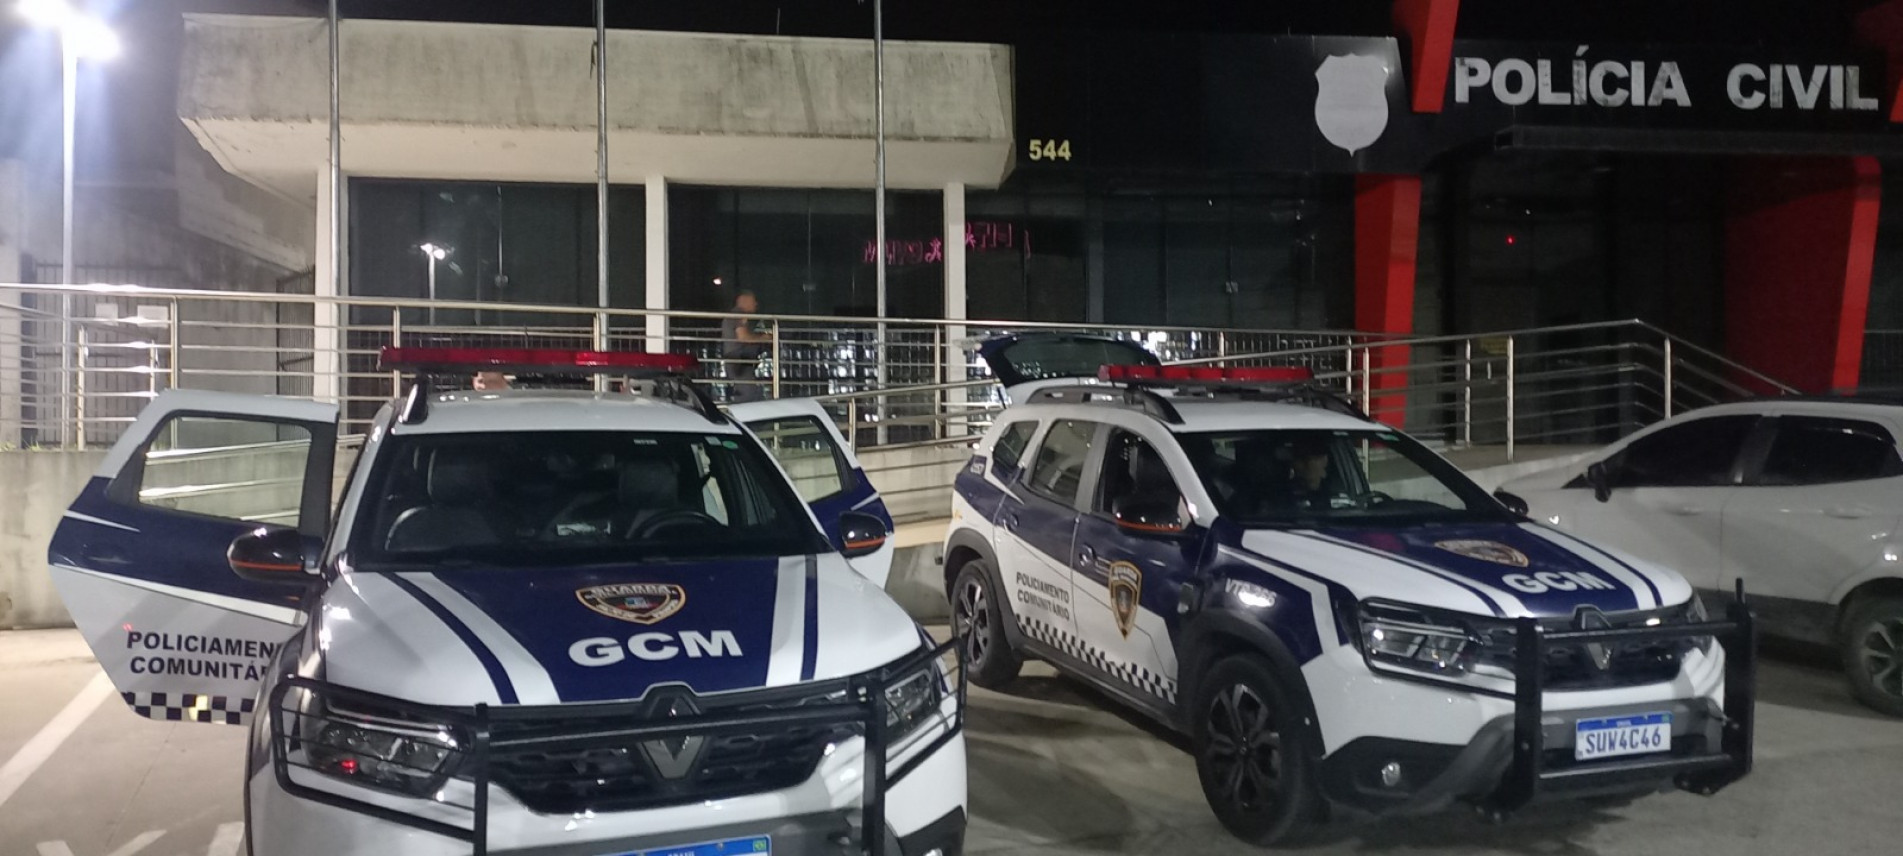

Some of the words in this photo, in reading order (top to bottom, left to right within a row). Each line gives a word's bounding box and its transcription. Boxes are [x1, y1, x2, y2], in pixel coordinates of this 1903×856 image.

[1455, 44, 1692, 108] POLÍCIA
[1726, 63, 1879, 111] CIVIL
[1029, 139, 1072, 161] 544
[1501, 571, 1616, 594] GCM
[126, 631, 281, 659] POLICIAMEN
[568, 630, 743, 667] GCM
[1585, 726, 1661, 755] SUW4C46
